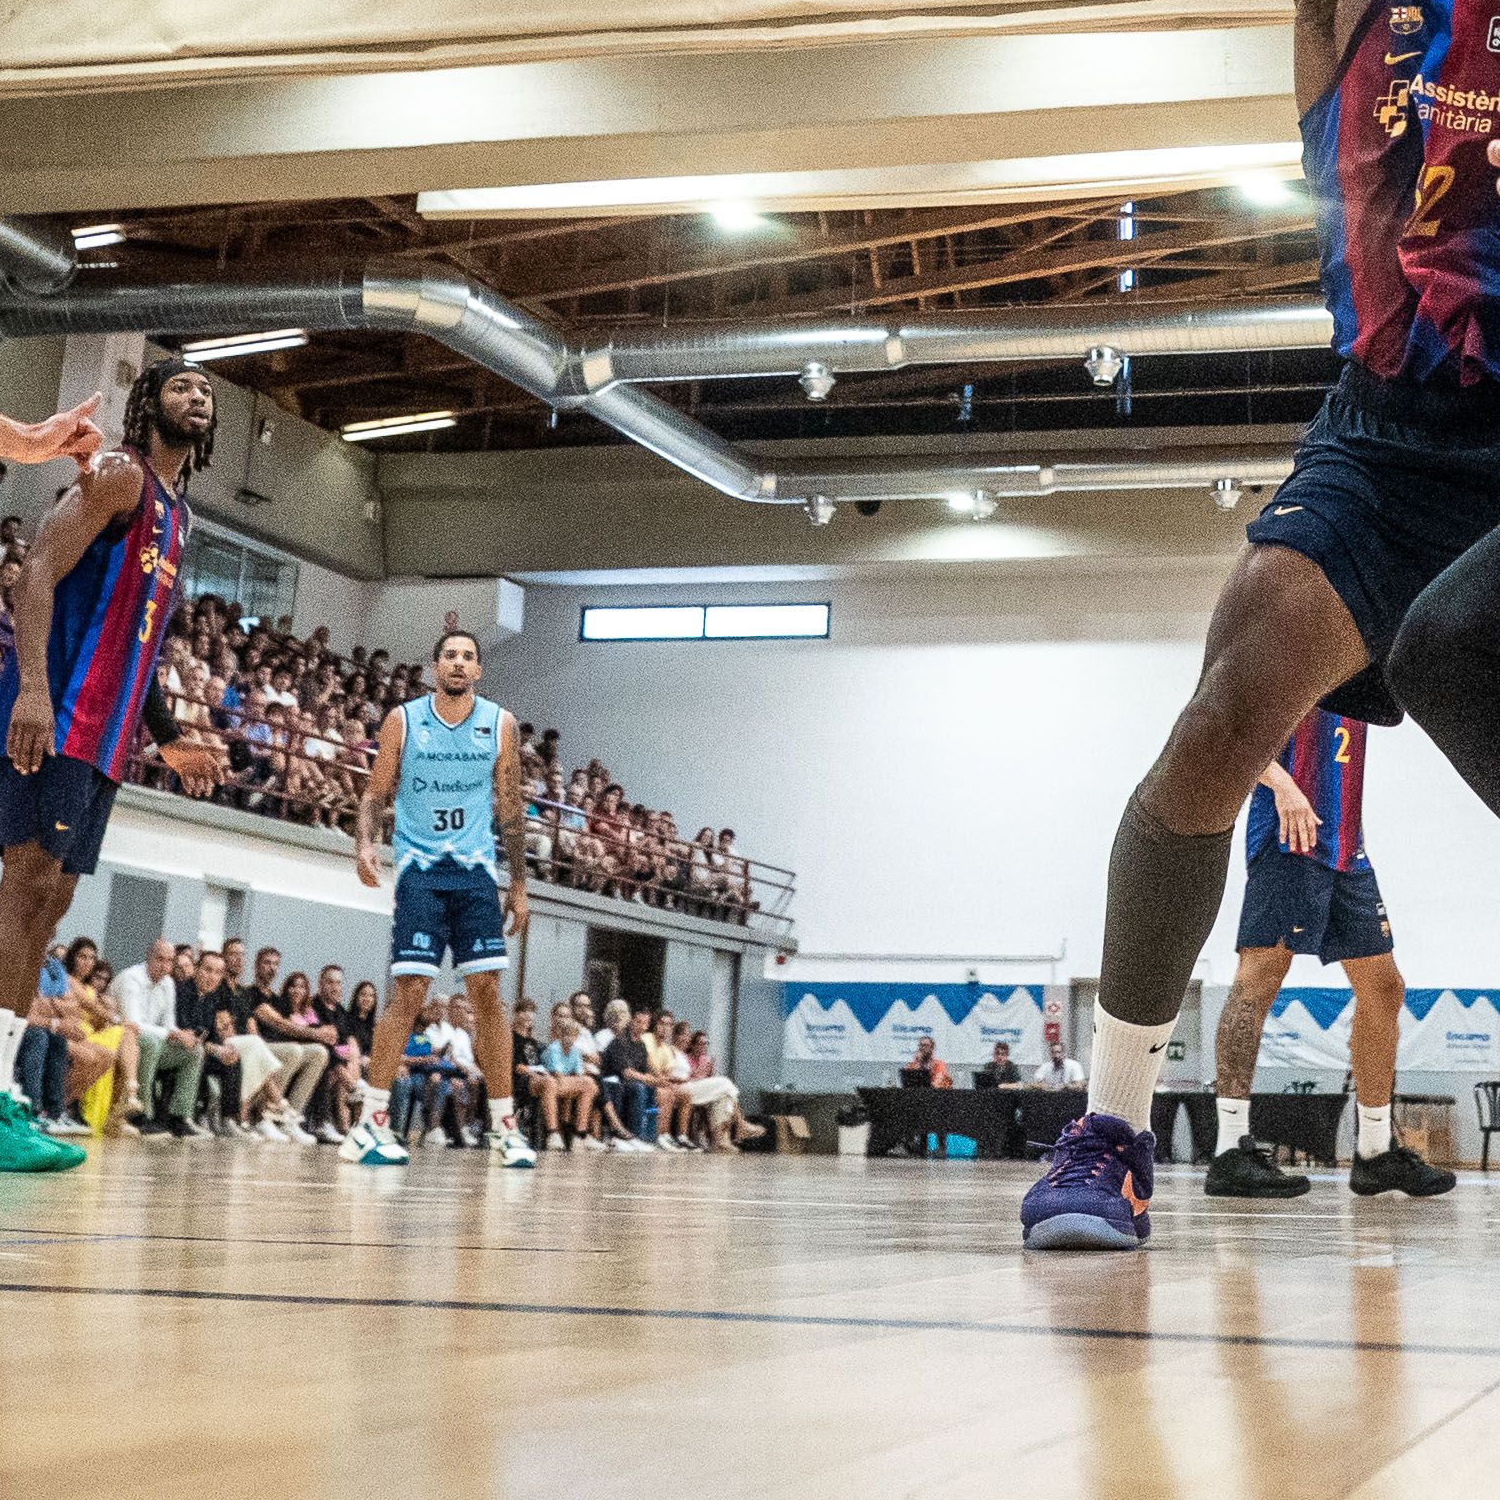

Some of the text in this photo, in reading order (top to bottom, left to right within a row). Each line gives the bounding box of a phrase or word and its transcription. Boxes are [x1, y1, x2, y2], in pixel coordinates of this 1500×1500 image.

[1409, 73, 1500, 112] Assistèn
[1416, 97, 1492, 133] anitària
[138, 598, 157, 644] 3
[1334, 727, 1351, 763] 2
[433, 807, 465, 832] 30
